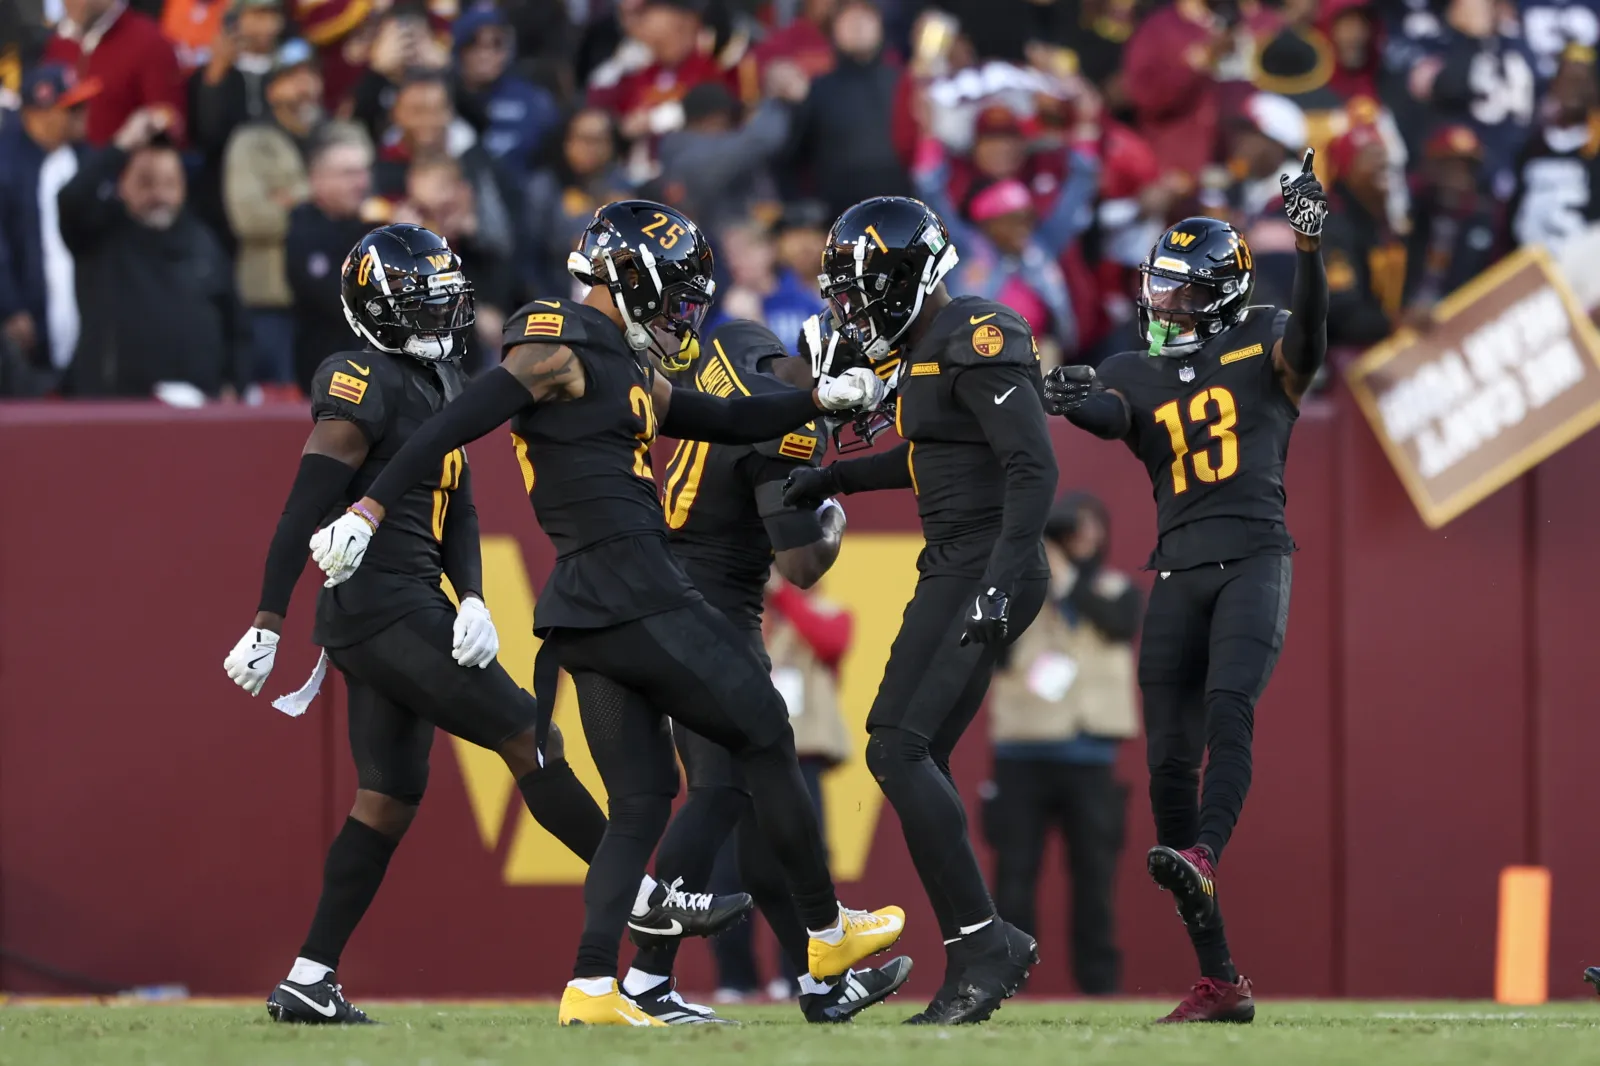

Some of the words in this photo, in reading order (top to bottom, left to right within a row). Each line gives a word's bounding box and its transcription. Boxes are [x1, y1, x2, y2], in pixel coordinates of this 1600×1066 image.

[641, 212, 686, 249] 25
[864, 225, 889, 254] 1
[1170, 231, 1197, 247] W
[426, 254, 451, 272] W
[1228, 238, 1253, 270] 13
[1220, 344, 1263, 364] COMMANDERS
[700, 355, 736, 398] MARTIN
[629, 385, 657, 480] 2
[1153, 386, 1239, 496] 13
[431, 448, 463, 544] 0
